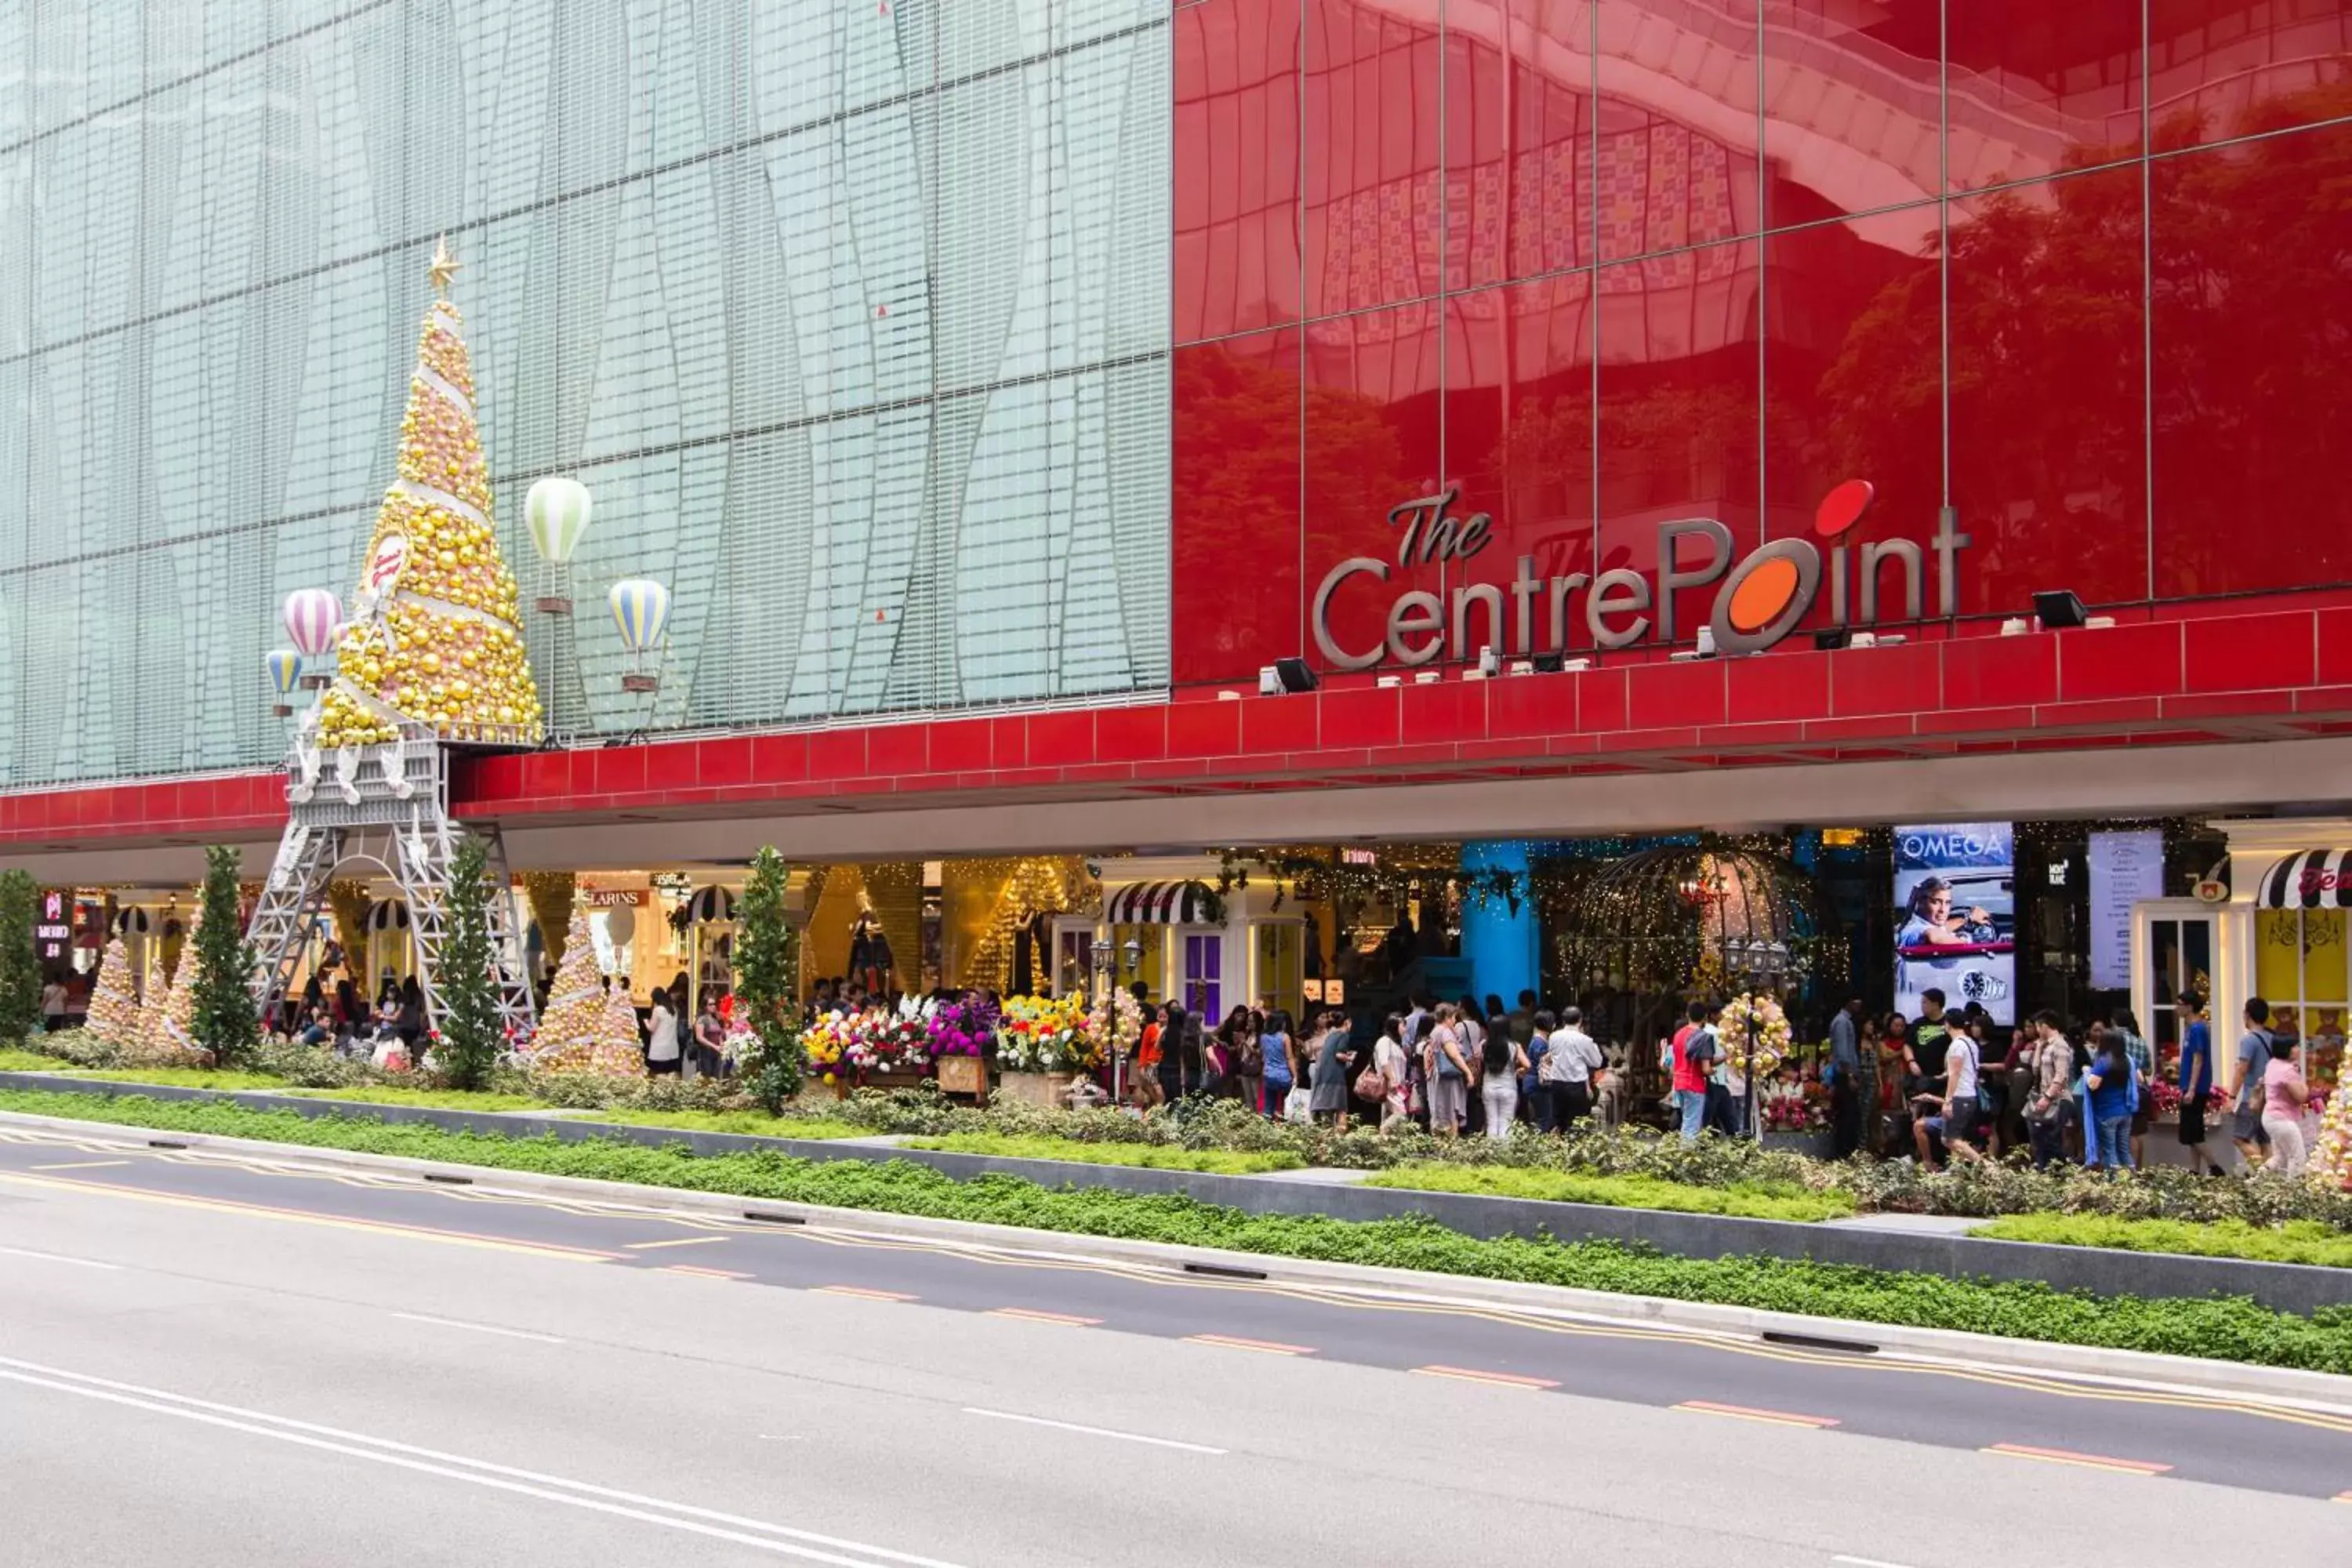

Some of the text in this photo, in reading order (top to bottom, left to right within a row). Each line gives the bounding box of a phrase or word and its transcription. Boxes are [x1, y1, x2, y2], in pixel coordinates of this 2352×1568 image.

[1387, 487, 1492, 568] The
[1312, 479, 1972, 670] CentrePoint
[1903, 833, 2005, 858] OMEGA
[586, 891, 640, 906] LARINS
